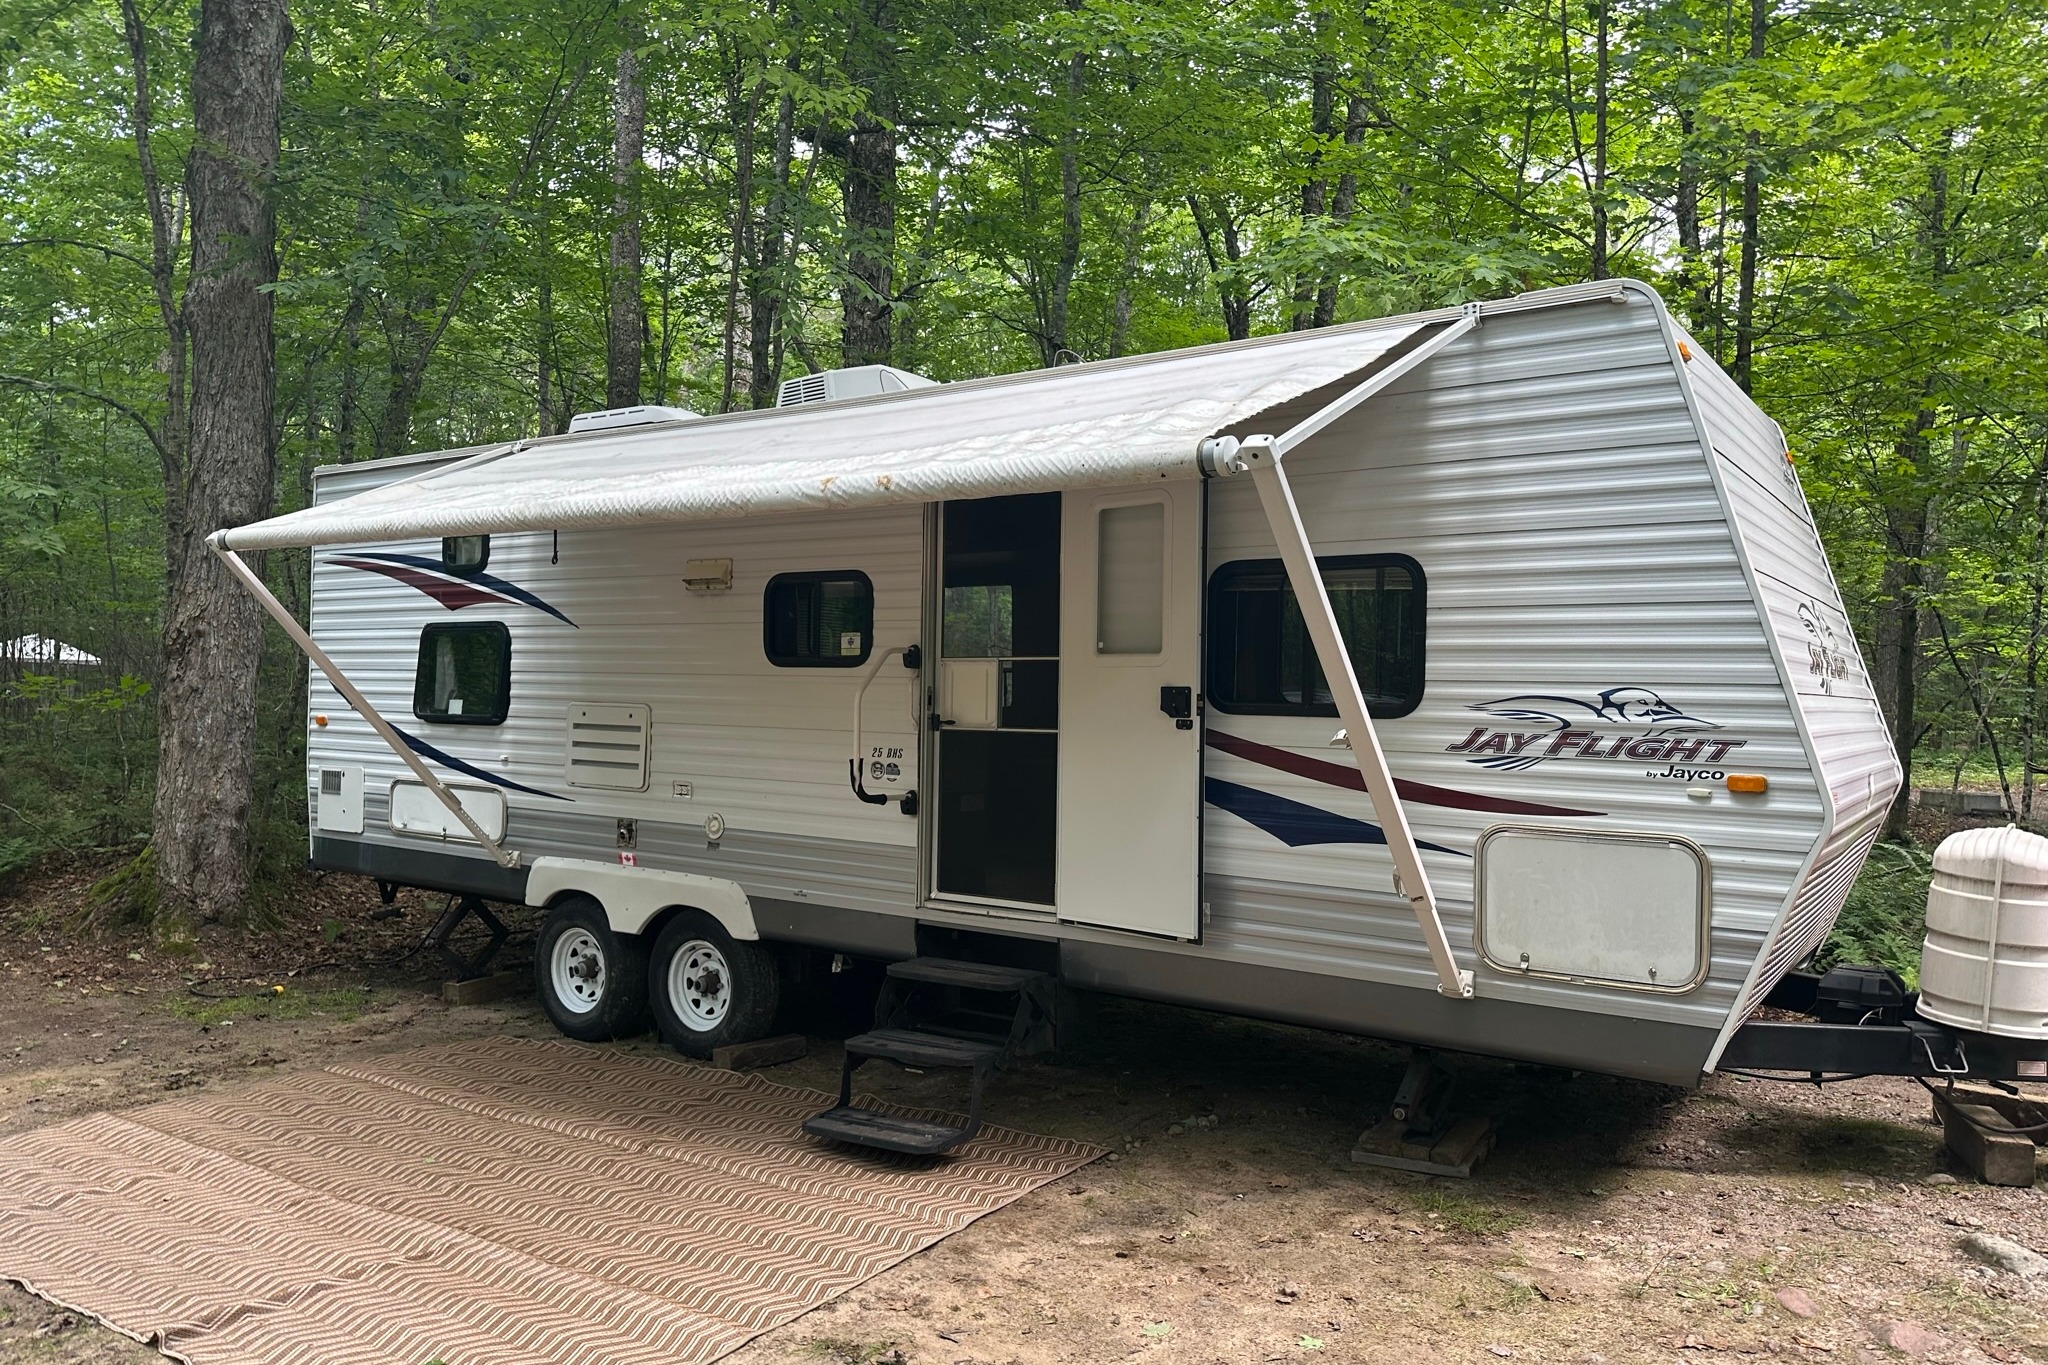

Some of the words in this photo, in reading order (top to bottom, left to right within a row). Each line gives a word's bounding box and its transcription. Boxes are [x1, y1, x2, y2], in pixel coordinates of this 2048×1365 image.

[871, 747, 883, 758] 25
[886, 747, 904, 759] BHS
[1445, 727, 1548, 755] JAY
[1543, 730, 1747, 763] FLIGHT
[1646, 770, 1658, 779] by
[1659, 765, 1726, 782] Jayco
